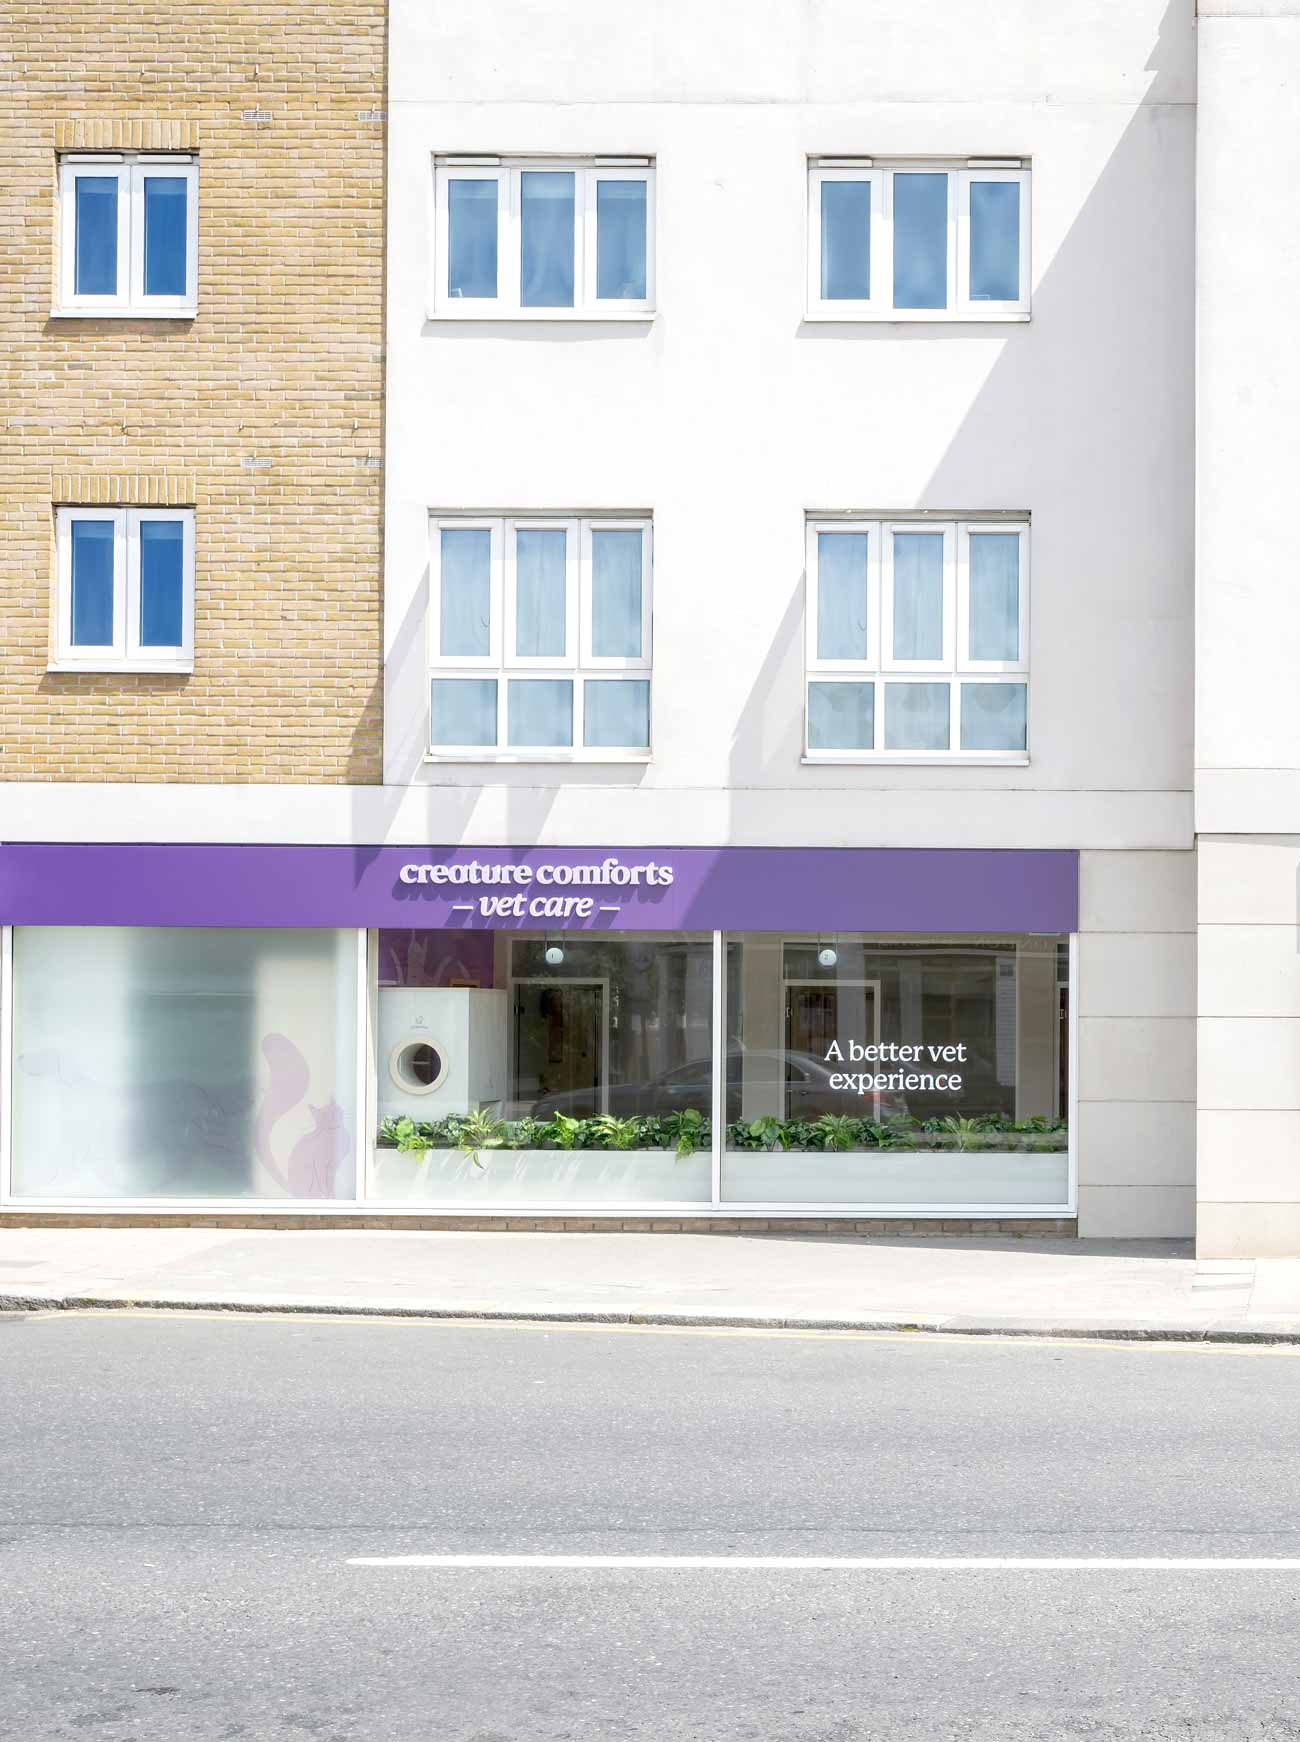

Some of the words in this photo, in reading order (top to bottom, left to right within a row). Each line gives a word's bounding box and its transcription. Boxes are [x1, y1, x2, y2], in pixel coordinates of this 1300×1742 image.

[399, 859, 533, 885] creature
[535, 857, 674, 886] comforts
[479, 893, 527, 917] vet
[528, 896, 595, 918] care
[824, 1039, 844, 1062] A
[848, 1039, 924, 1062] better
[927, 1043, 967, 1063] vet
[829, 1068, 962, 1095] experience
